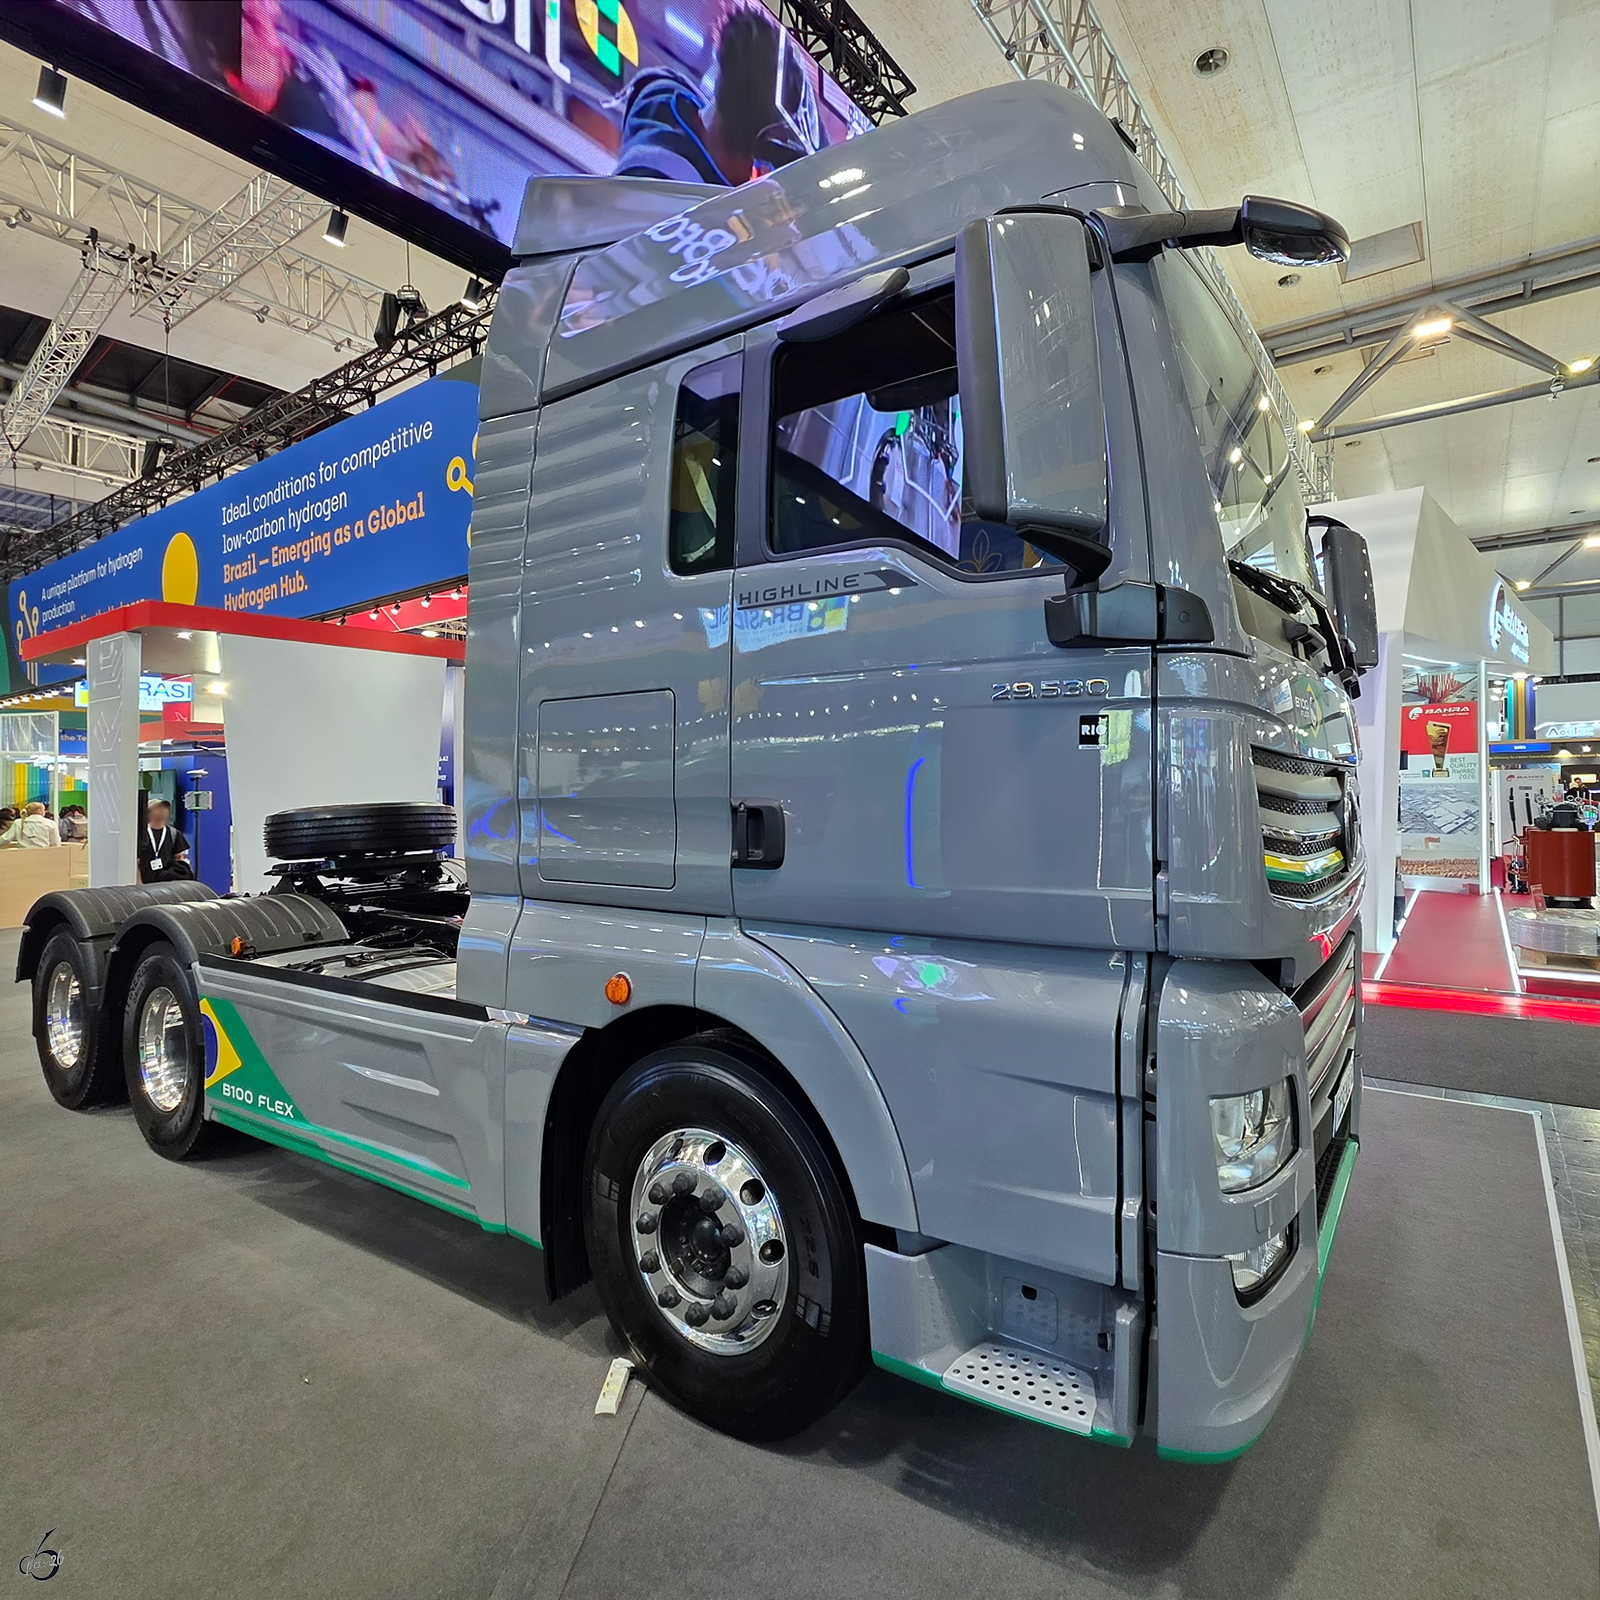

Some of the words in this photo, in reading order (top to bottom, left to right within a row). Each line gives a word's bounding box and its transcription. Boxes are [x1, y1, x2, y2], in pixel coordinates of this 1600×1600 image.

[221, 496, 251, 526] Ideal
[252, 471, 316, 513] conditions
[318, 461, 338, 485] for
[341, 420, 433, 475] competitive
[222, 517, 286, 554] low-carbon
[287, 491, 348, 533] hydrogen
[223, 553, 257, 584] Brazil
[271, 530, 331, 568] Emerging
[333, 524, 351, 546] as
[354, 518, 365, 539] a
[367, 491, 425, 535] Global
[41, 588, 47, 601] A
[46, 579, 67, 600] unique
[67, 567, 96, 595] platform
[97, 562, 107, 579] for
[107, 547, 144, 577] hydrogen
[224, 582, 278, 611] Hydrogen
[279, 570, 308, 598] Hub.
[739, 573, 860, 606] HIGHLINE
[42, 600, 76, 626] production
[139, 681, 191, 698] RASI
[991, 677, 1110, 701] 29.530
[1081, 725, 1107, 736] RIO
[222, 1083, 253, 1104] B100
[257, 1094, 295, 1119] FLEX
